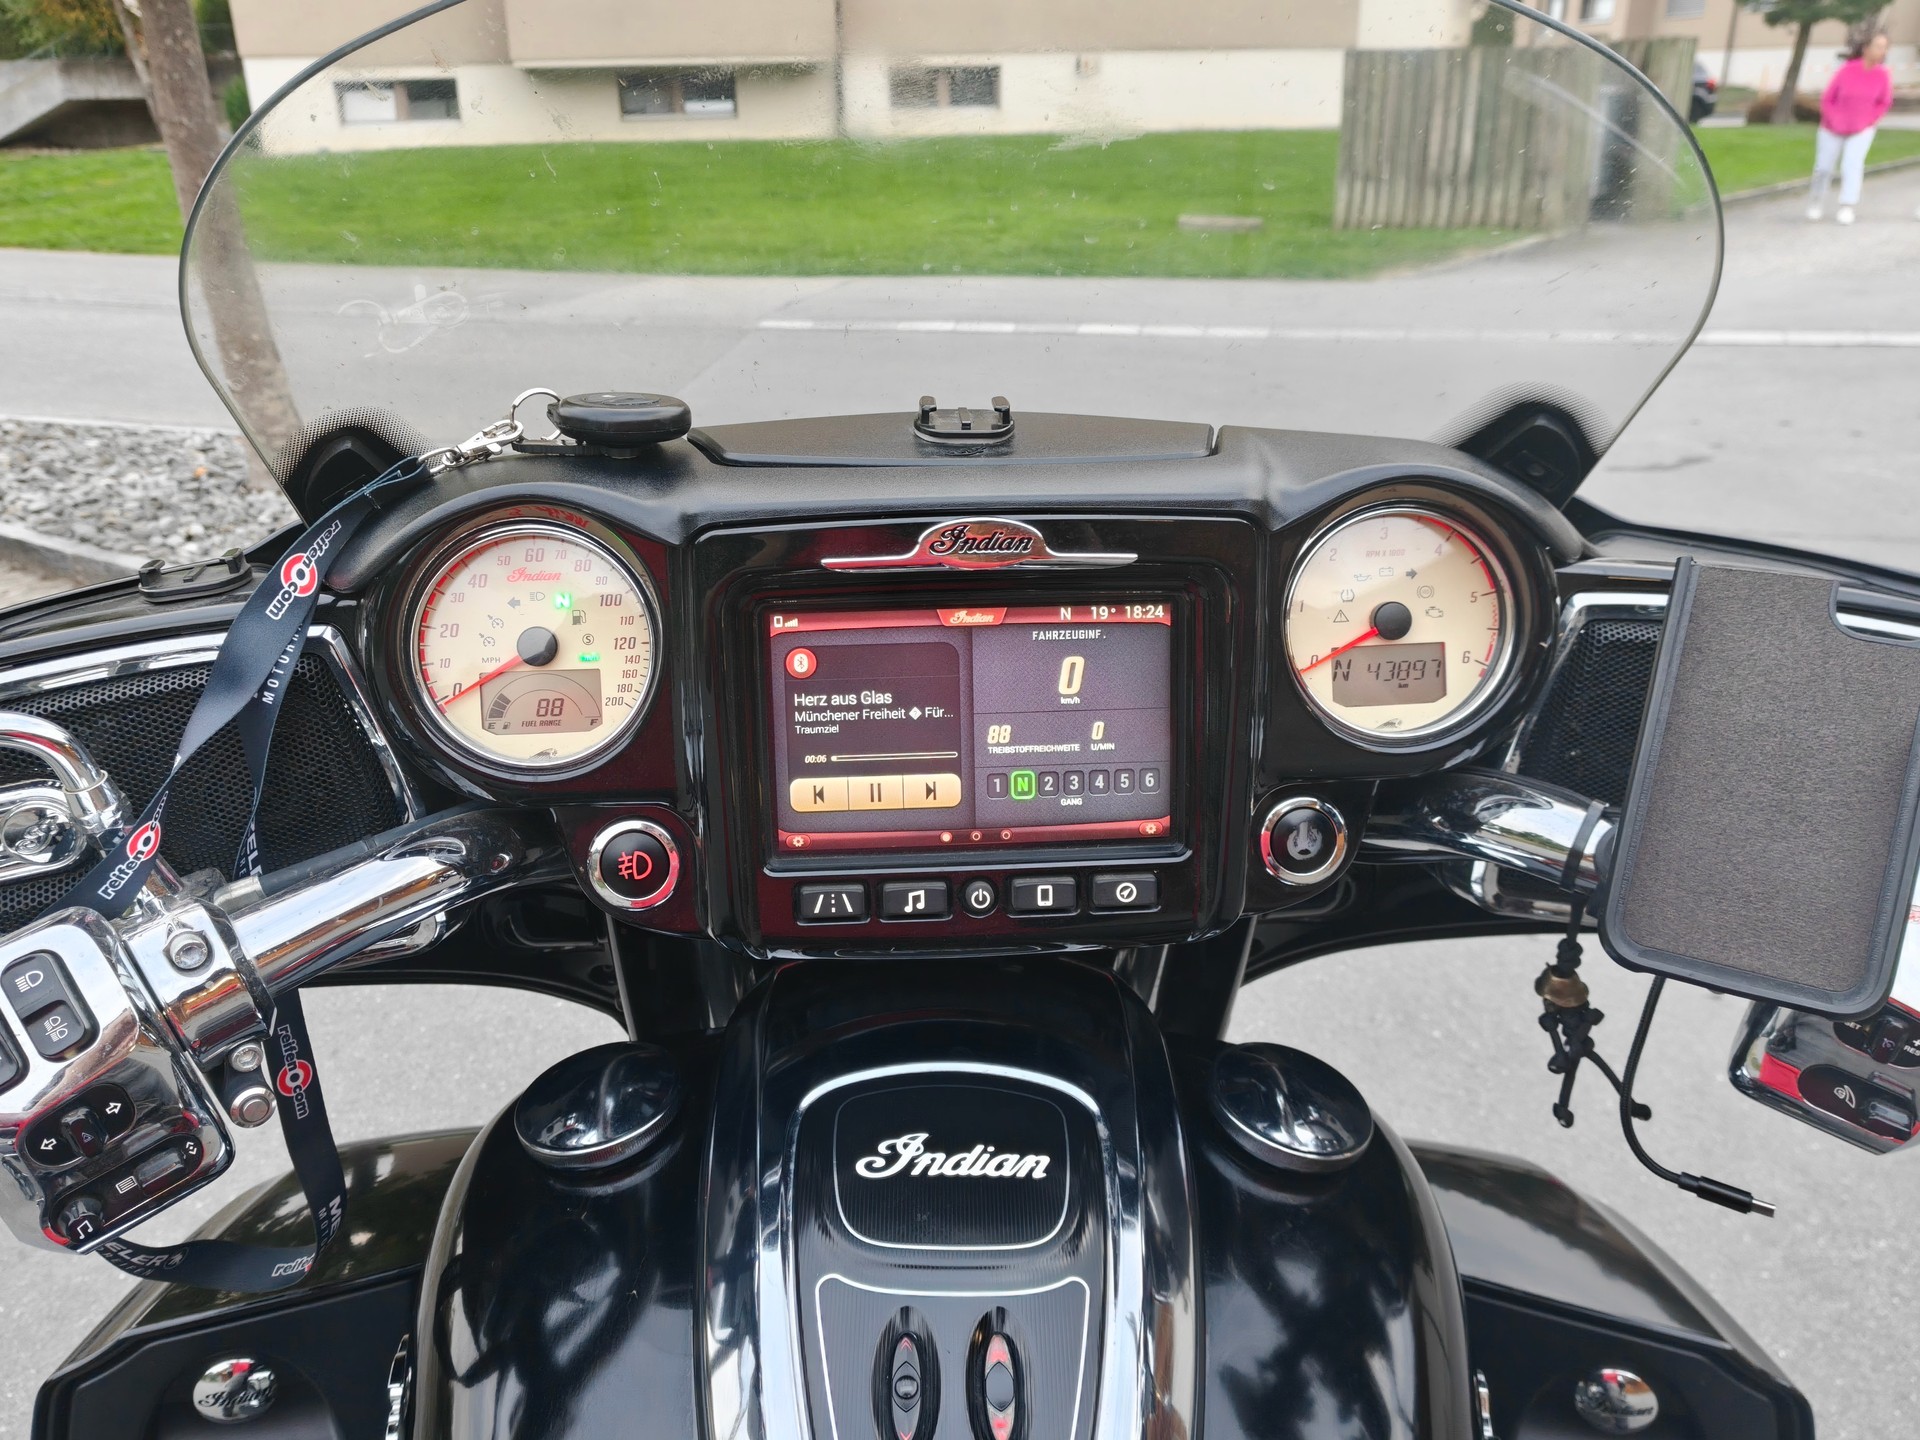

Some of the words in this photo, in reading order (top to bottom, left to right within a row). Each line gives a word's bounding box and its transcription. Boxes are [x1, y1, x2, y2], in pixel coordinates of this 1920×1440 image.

[1380, 527, 1389, 540] 3
[929, 525, 1033, 556] Indian
[524, 548, 545, 563] 60
[554, 550, 567, 560] 70
[1329, 548, 1338, 561] 2
[1365, 550, 1380, 558] RPM
[1434, 544, 1443, 557] 4
[497, 556, 510, 566] 50
[574, 559, 592, 572] 80
[468, 574, 488, 588] 40
[507, 567, 562, 583] Indian
[595, 576, 608, 586] 90
[450, 593, 465, 603] 30
[555, 593, 571, 608] N
[599, 594, 623, 607] 100
[1470, 592, 1478, 603] 5
[950, 610, 994, 624] Indian
[1060, 607, 1071, 620] N
[1091, 606, 1116, 620] 19°
[1125, 605, 1164, 619] 18:24
[620, 616, 634, 626] 110
[440, 624, 459, 638] 20
[614, 637, 637, 650] 120
[439, 658, 451, 668] 10
[625, 655, 641, 664] 140
[1462, 651, 1471, 664] 6
[622, 669, 638, 679] 160
[1058, 656, 1085, 695] 0
[1332, 659, 1352, 682] N
[1367, 659, 1442, 681] 43897
[617, 684, 633, 693] 180
[605, 697, 624, 706] 200
[794, 693, 828, 706] Herz
[831, 694, 857, 705] aus
[860, 690, 892, 705] Glas
[1060, 696, 1080, 705] km/h
[536, 698, 564, 717] 88
[794, 710, 860, 722] Münchener
[862, 708, 906, 720] Freiheit
[539, 719, 562, 727] RANGE
[795, 724, 839, 735] Traumziel
[987, 725, 1012, 744] 88
[1091, 721, 1105, 740] 0
[988, 744, 1080, 754] TREIBSTOFFREICHWEITE
[1091, 743, 1115, 751] U/MIN
[804, 755, 827, 764] 00:06
[993, 778, 1000, 792] 1
[1017, 777, 1029, 792] N
[1044, 776, 1054, 791] 2
[1069, 775, 1079, 790] 3
[1095, 774, 1104, 789] 4
[1120, 774, 1129, 788] 5
[1145, 773, 1155, 787] 6
[1060, 798, 1082, 806] GANG
[855, 1133, 1051, 1179] Indian
